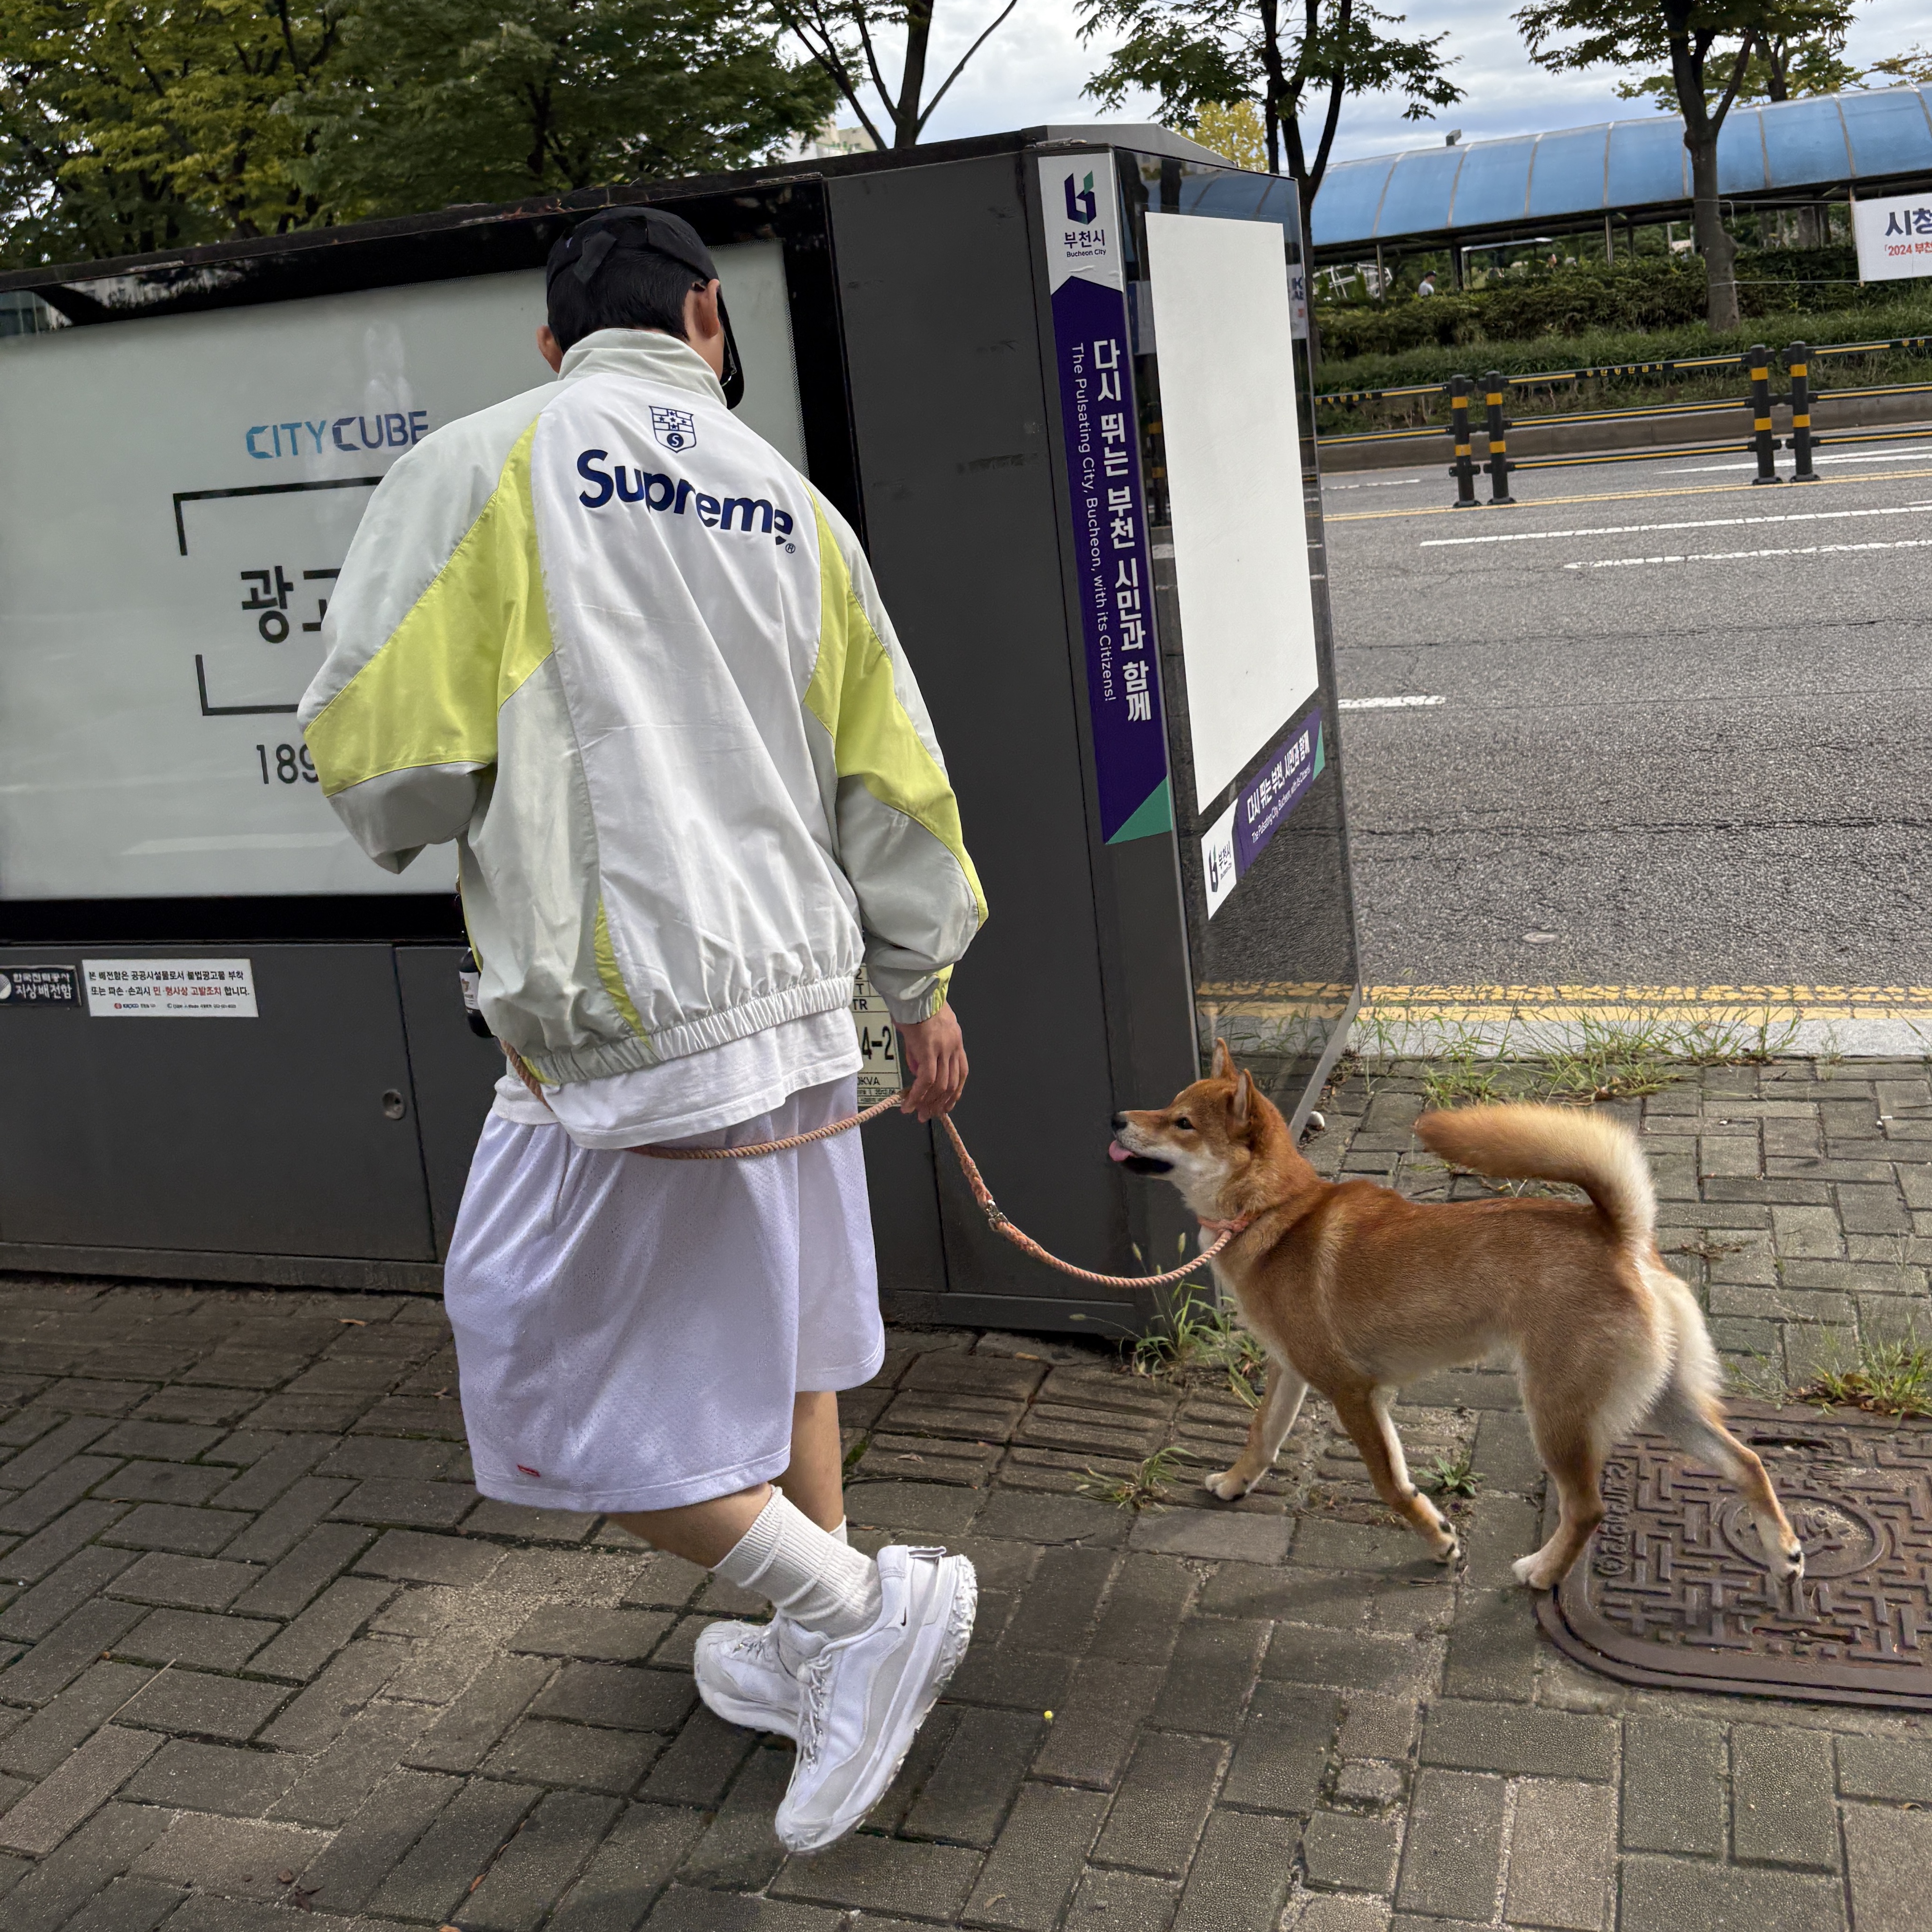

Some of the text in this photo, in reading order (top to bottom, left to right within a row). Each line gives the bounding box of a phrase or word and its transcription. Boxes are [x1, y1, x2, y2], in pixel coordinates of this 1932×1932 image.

[1064, 229, 1105, 249] 부천시
[577, 449, 793, 545] Supreme
[1072, 343, 1117, 701] The Pulsating City, Bucheon, with its Citizens!
[1094, 339, 1151, 722] 다시 뛰는 부천 시민과 함께
[1247, 788, 1261, 824] 다시
[91, 987, 106, 996] 또는
[191, 986, 221, 996] 고발조치
[131, 971, 184, 981] 공공시설물로서
